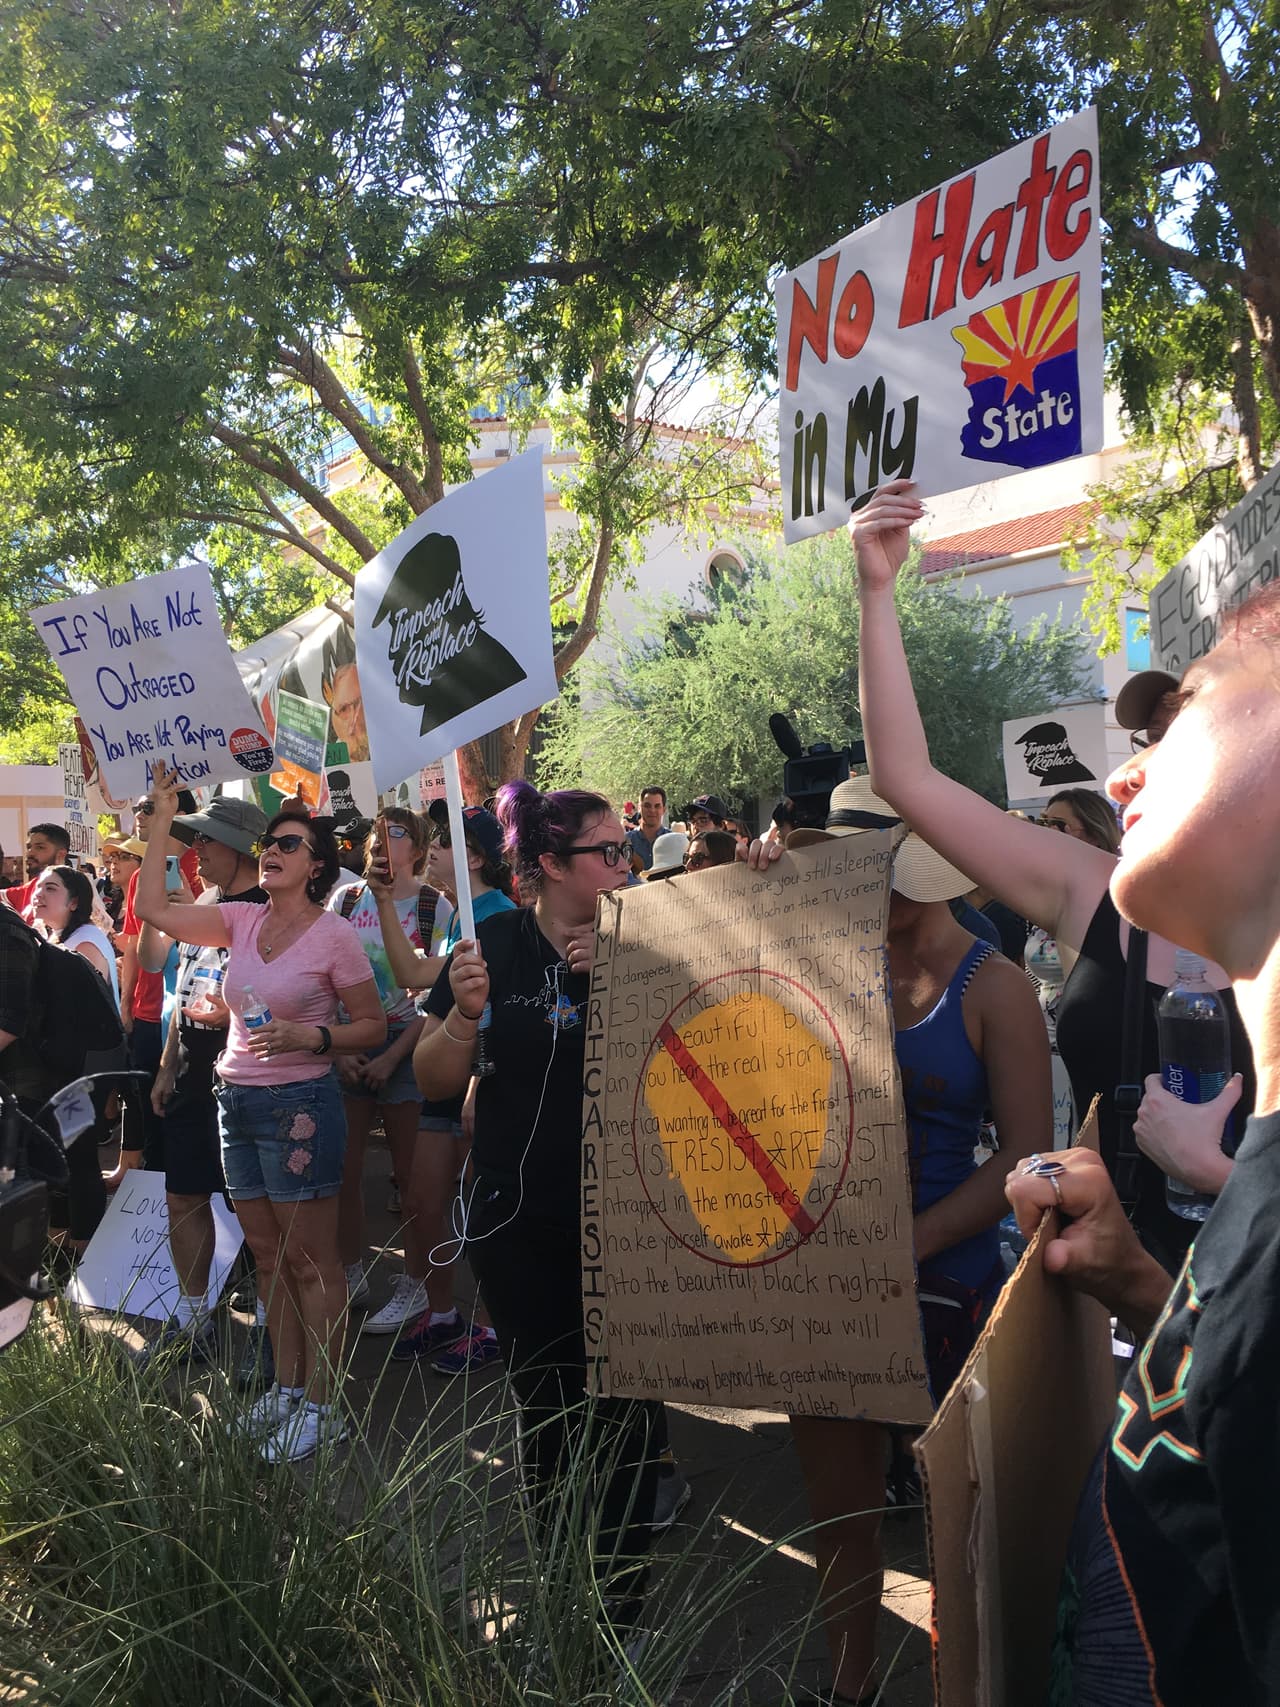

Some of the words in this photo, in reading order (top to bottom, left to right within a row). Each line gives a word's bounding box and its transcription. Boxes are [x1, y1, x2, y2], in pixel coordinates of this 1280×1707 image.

[898, 133, 1093, 329] Hate
[791, 409, 828, 521] in
[980, 388, 1074, 449] State
[390, 570, 465, 654] Impeach
[1158, 550, 1211, 653] EGO
[424, 616, 443, 647] and
[397, 619, 478, 691] Replace
[231, 733, 260, 746] DUMP
[235, 740, 263, 752] TRUMP
[1024, 738, 1068, 757] Impeach
[436, 778, 446, 786] RE
[1029, 753, 1074, 772] Replace
[752, 882, 772, 895] are
[773, 874, 799, 896] you
[804, 856, 831, 883] still
[784, 904, 794, 915] on
[799, 896, 819, 910] the
[676, 955, 694, 971] the
[852, 908, 882, 932] mind
[798, 944, 885, 991] RESIST
[642, 1028, 666, 1054] the
[672, 1007, 767, 1051] beautiful
[783, 992, 841, 1029] black
[636, 1069, 666, 1106] you
[671, 1058, 702, 1084] hear
[708, 1054, 729, 1080] the
[733, 1040, 767, 1075] real
[776, 1043, 841, 1068] stories
[664, 1107, 709, 1139] wanting
[712, 1105, 723, 1128] to
[738, 1098, 767, 1135] great
[771, 1095, 785, 1118] for
[790, 1090, 808, 1115] the
[811, 1082, 840, 1113] first
[844, 1069, 890, 1103] time?
[685, 1134, 761, 1172] RESIST
[790, 1123, 897, 1171] RESIST
[674, 1189, 688, 1213] in
[694, 1187, 718, 1213] the
[808, 1178, 882, 1205] dream
[661, 1224, 711, 1264] yourself
[714, 1225, 753, 1249] awake
[773, 1213, 828, 1267] beyond
[833, 1208, 860, 1247] the
[862, 1204, 898, 1244] veil
[645, 1266, 669, 1294] the
[763, 1263, 819, 1295] black
[625, 1319, 647, 1346] you
[649, 1311, 669, 1339] will
[671, 1313, 700, 1339] stand
[700, 1313, 719, 1337] here
[720, 1311, 746, 1336] with
[770, 1316, 794, 1342] say
[802, 1317, 832, 1345] you
[842, 1313, 880, 1340] will
[637, 1359, 664, 1390] that
[665, 1359, 688, 1389] hard
[711, 1359, 753, 1393] beyond
[755, 1360, 778, 1387] the
[780, 1362, 816, 1394] great
[819, 1360, 848, 1384] white
[886, 1351, 897, 1385] of
